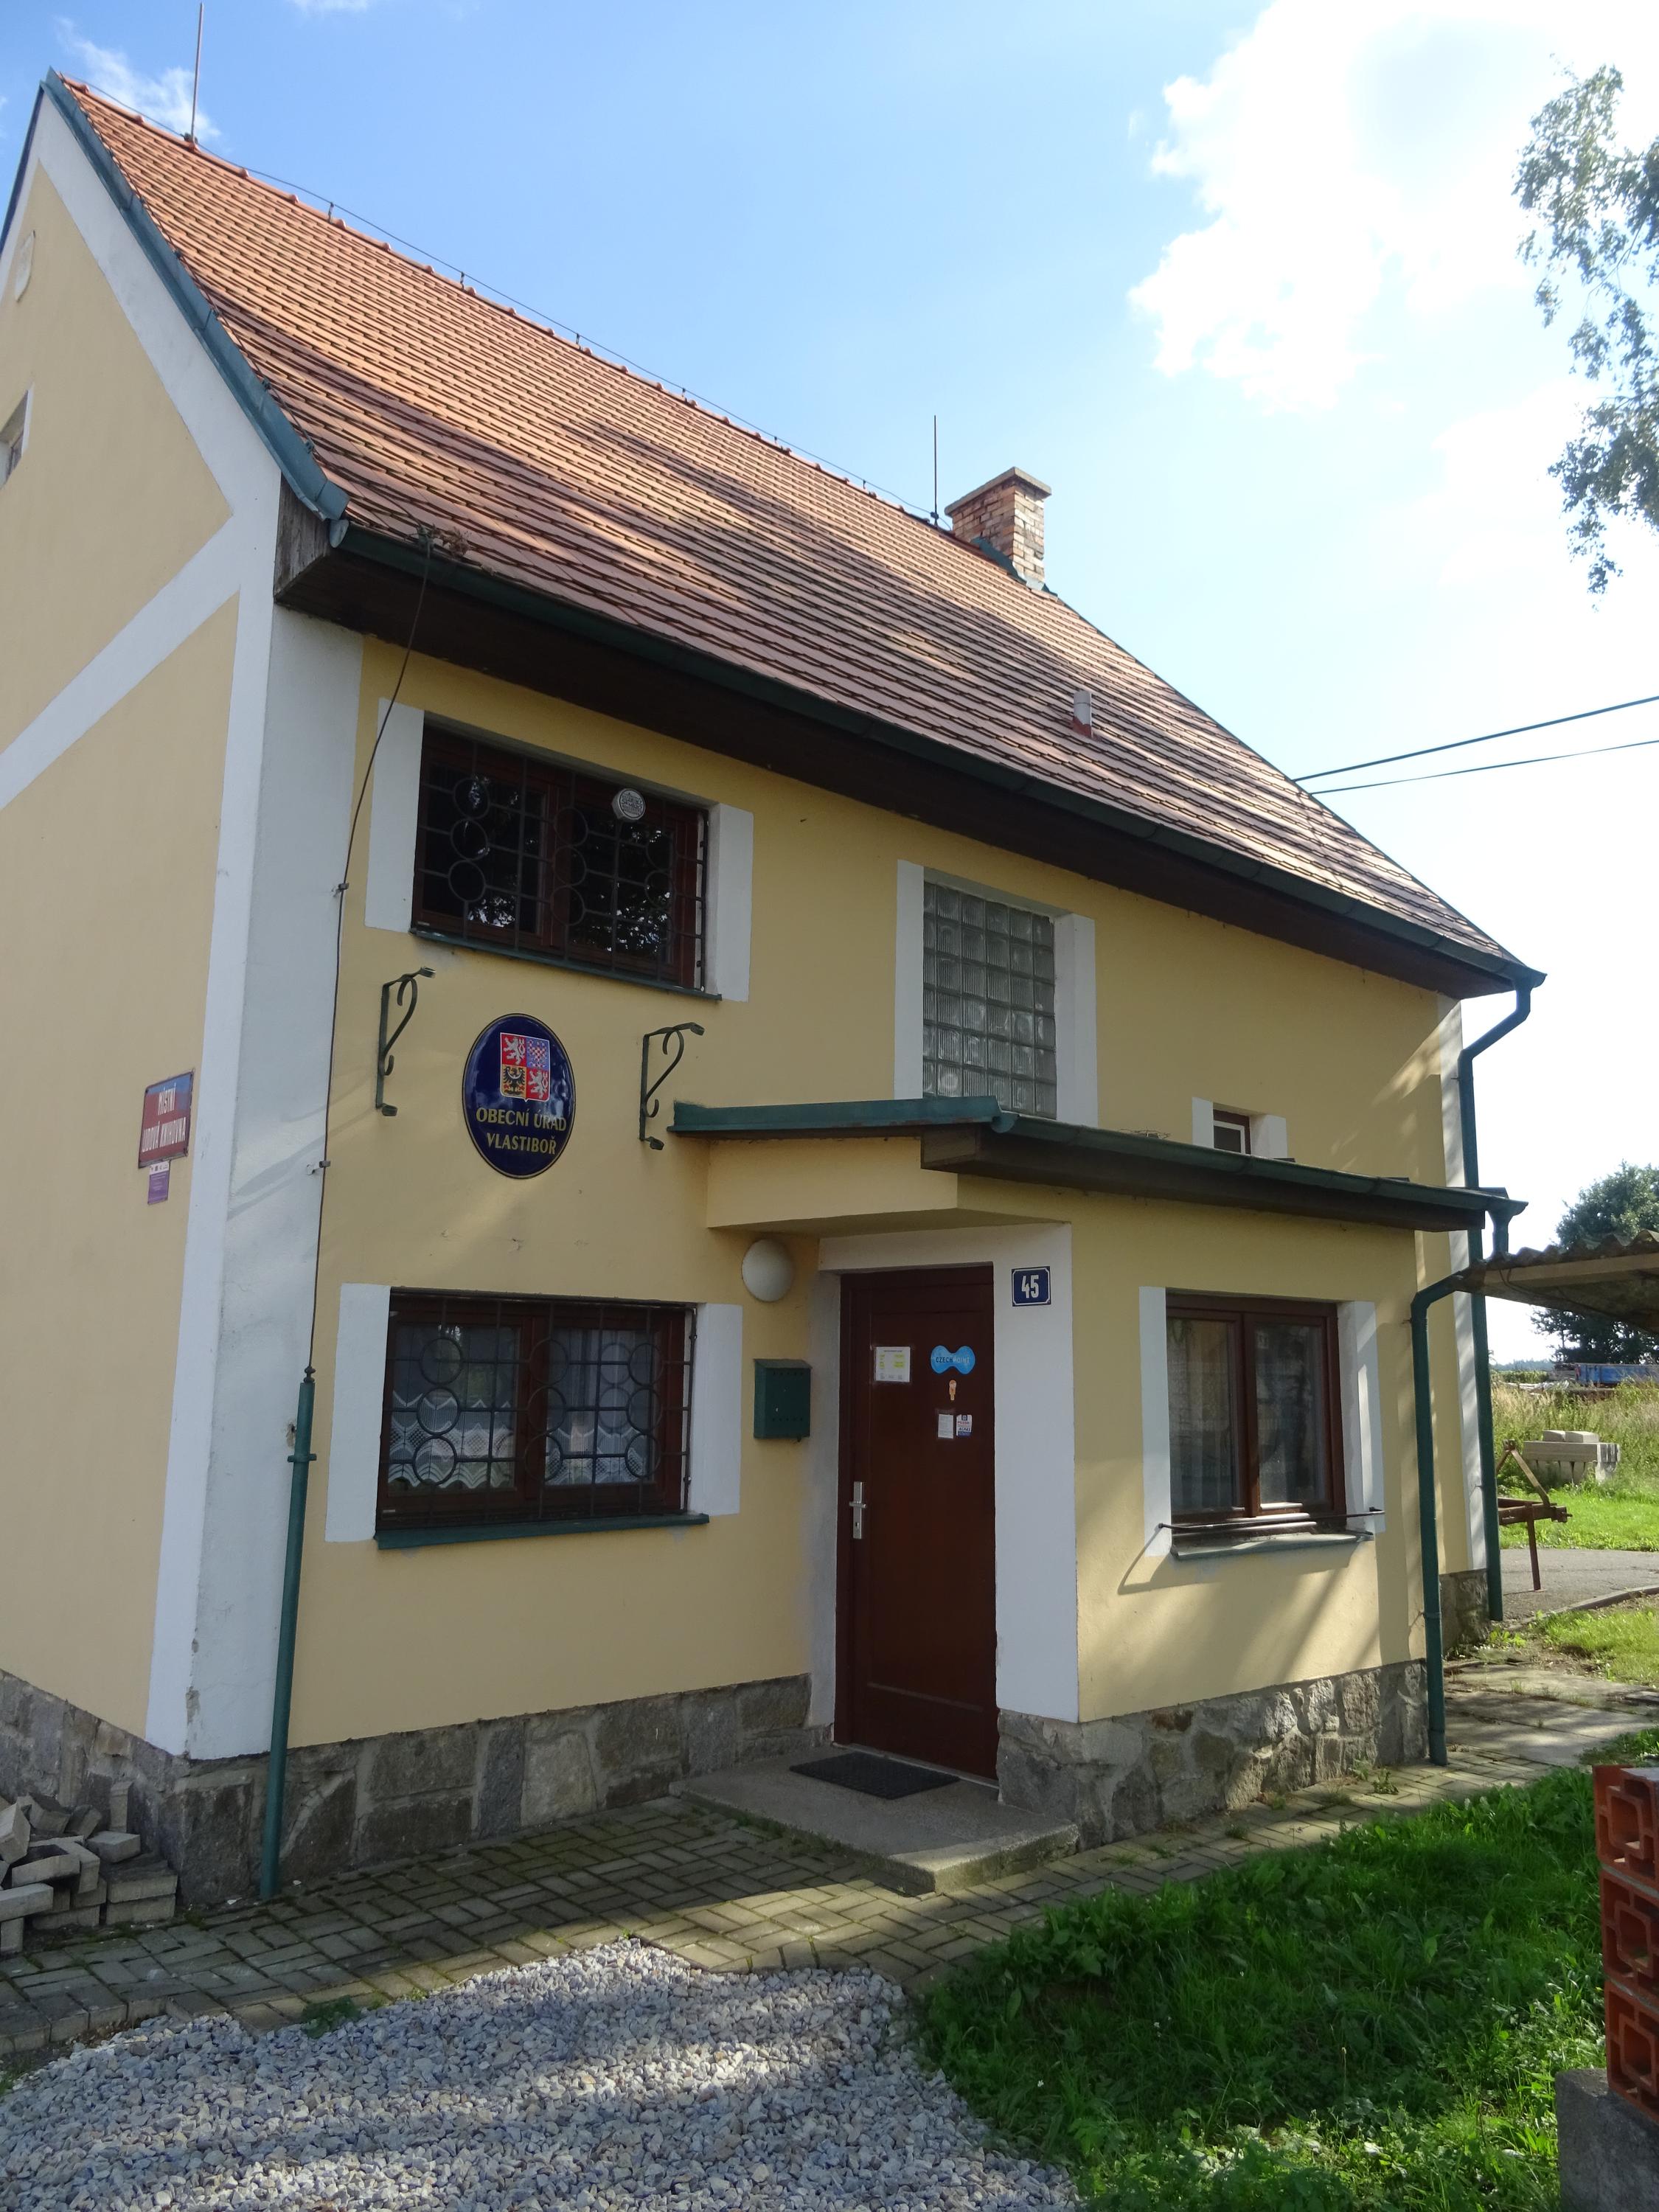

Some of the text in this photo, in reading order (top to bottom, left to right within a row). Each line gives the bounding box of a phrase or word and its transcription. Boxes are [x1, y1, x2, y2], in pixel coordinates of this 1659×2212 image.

[158, 1082, 176, 1115] MÍSTNÍ
[476, 1107, 529, 1127] OBECNÍ
[160, 1117, 186, 1147] KNIHOVNA
[486, 1132, 557, 1155] VLASTIBOŘ
[1021, 1274, 1040, 1298] 45
